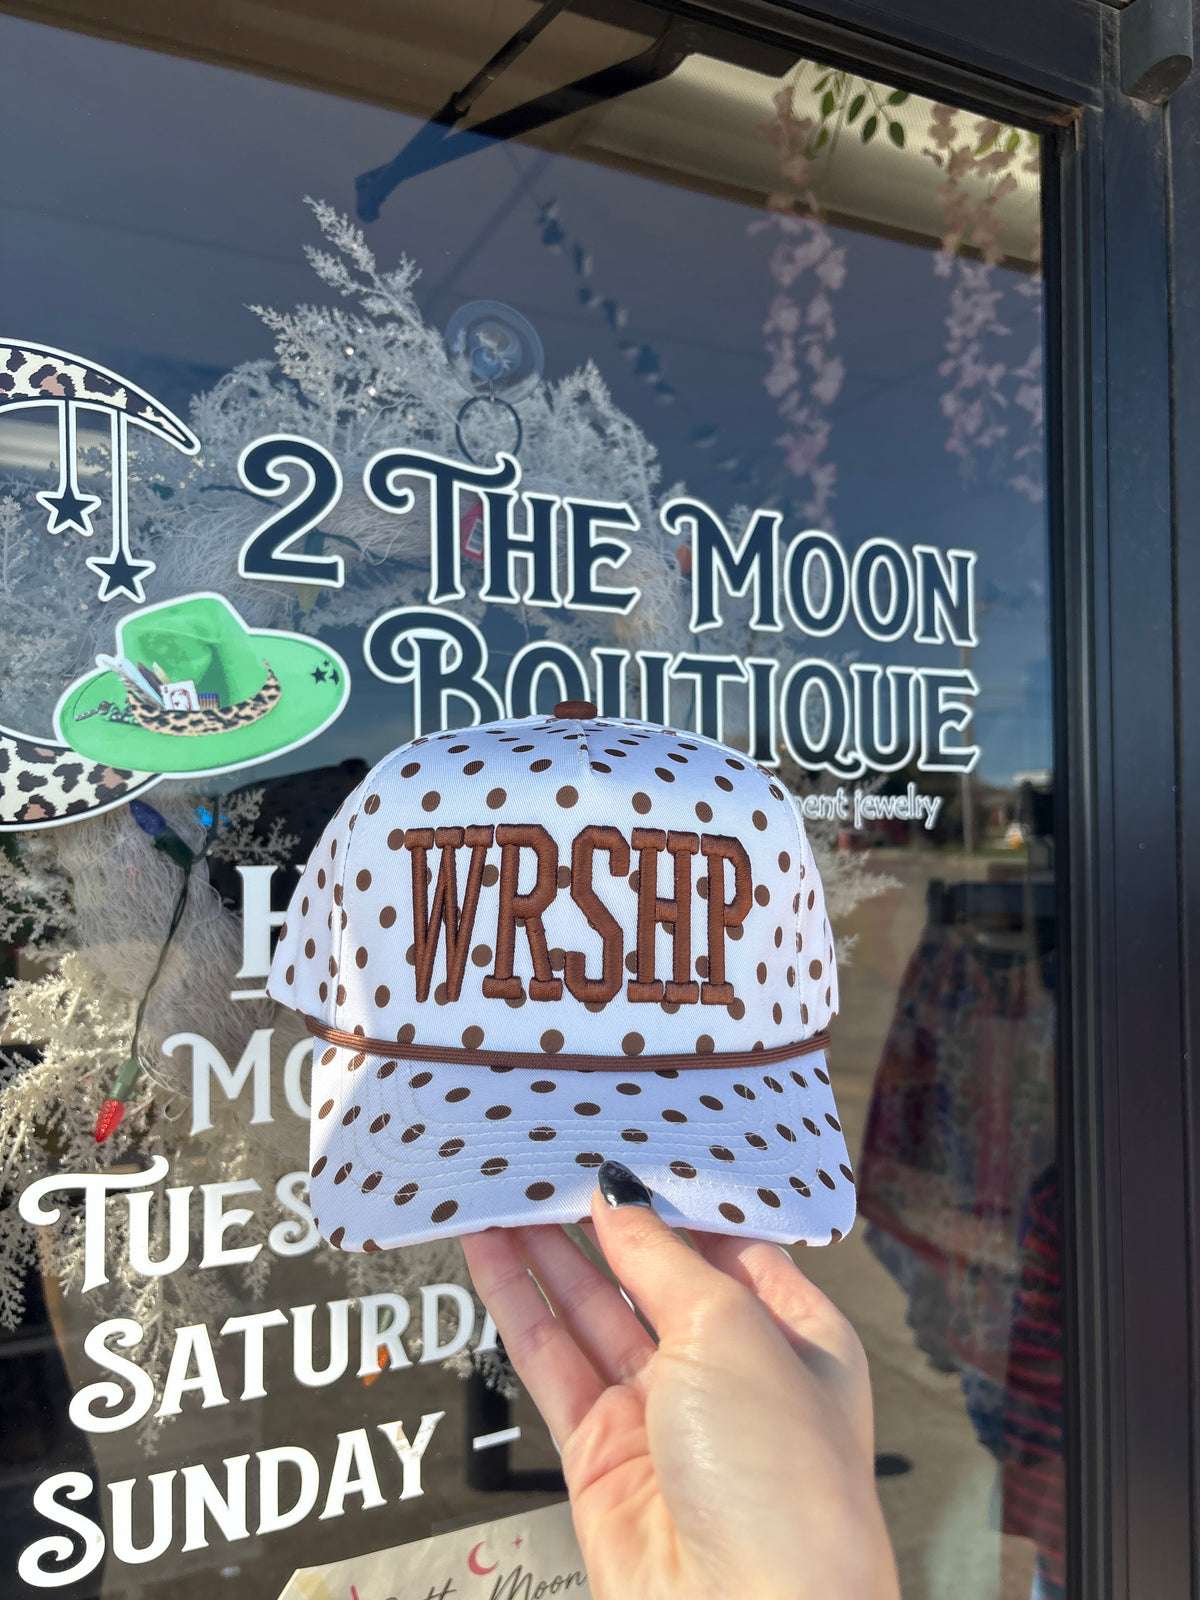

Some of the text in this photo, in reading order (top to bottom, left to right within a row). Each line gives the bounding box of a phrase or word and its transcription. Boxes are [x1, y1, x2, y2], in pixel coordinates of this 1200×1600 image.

[237, 434, 978, 648] 2 THE MOON
[794, 781, 943, 830] ent jewelry
[404, 823, 753, 1006] WRSHP
[18, 1155, 322, 1294] TUES
[17, 1411, 446, 1588] SUNDAY
